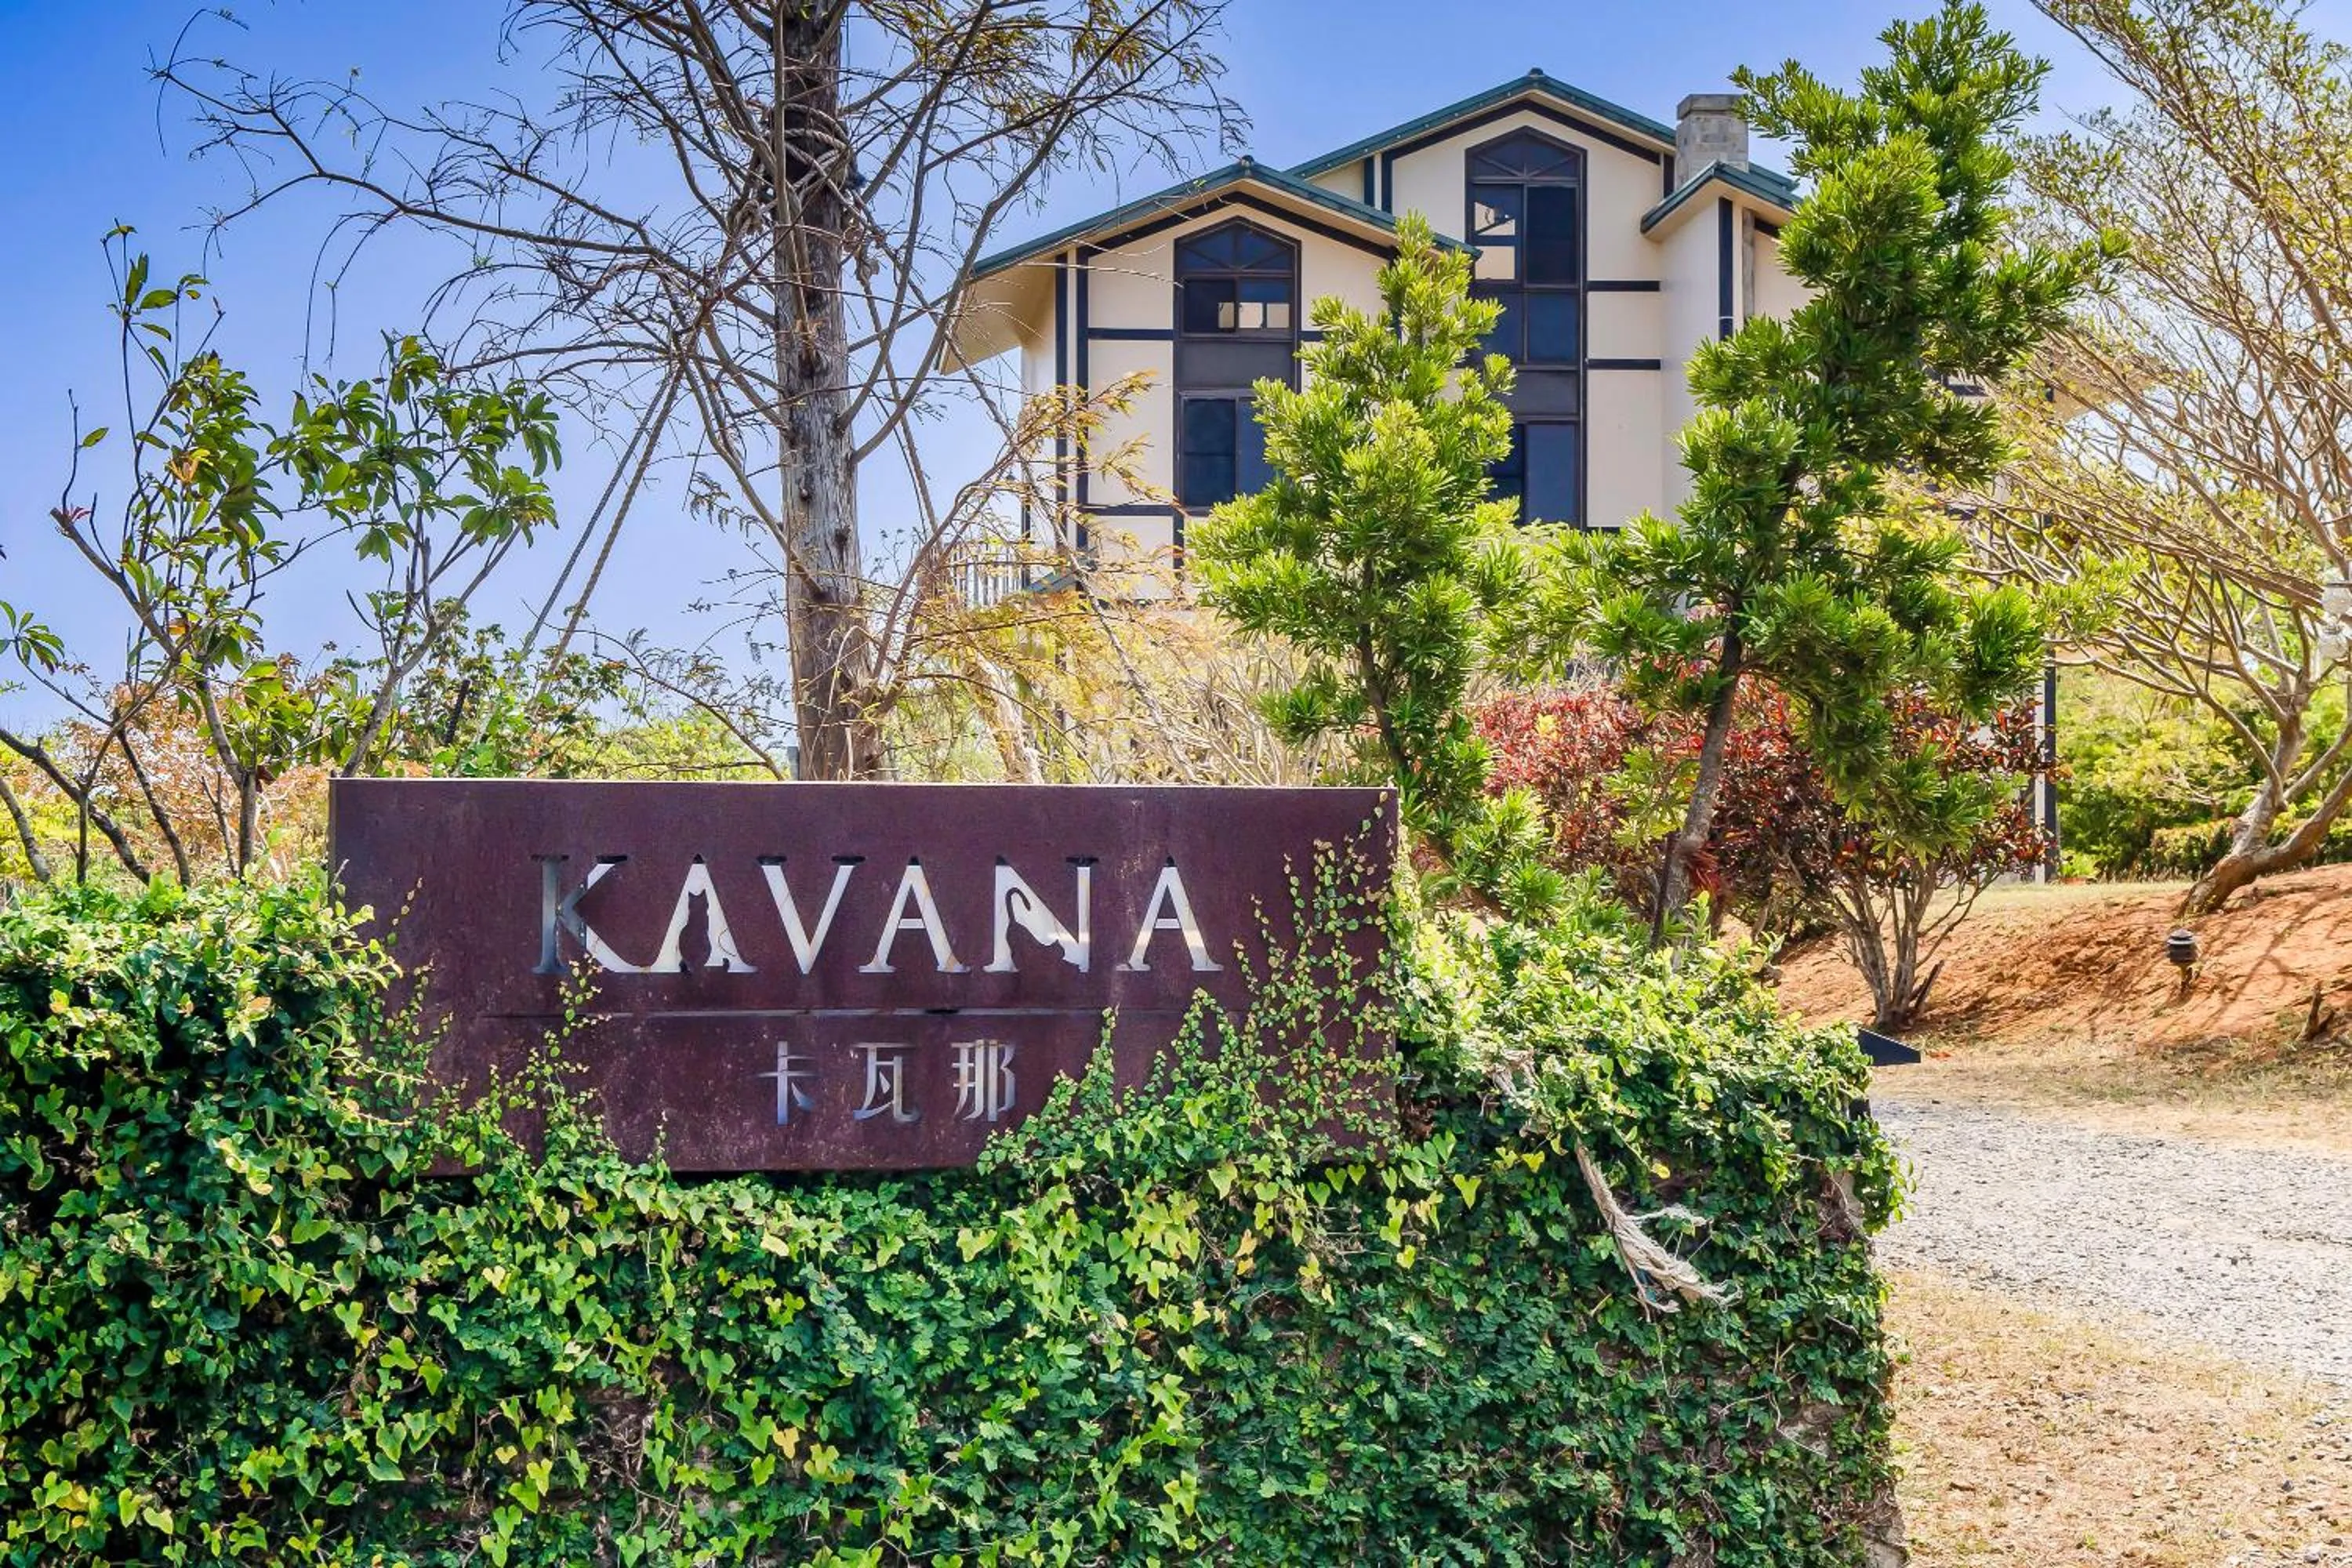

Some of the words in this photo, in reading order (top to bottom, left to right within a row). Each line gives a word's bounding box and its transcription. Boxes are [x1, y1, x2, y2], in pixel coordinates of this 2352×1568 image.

[531, 854, 1225, 975] KAVANA
[756, 1039, 1017, 1125] 卡瓦那
